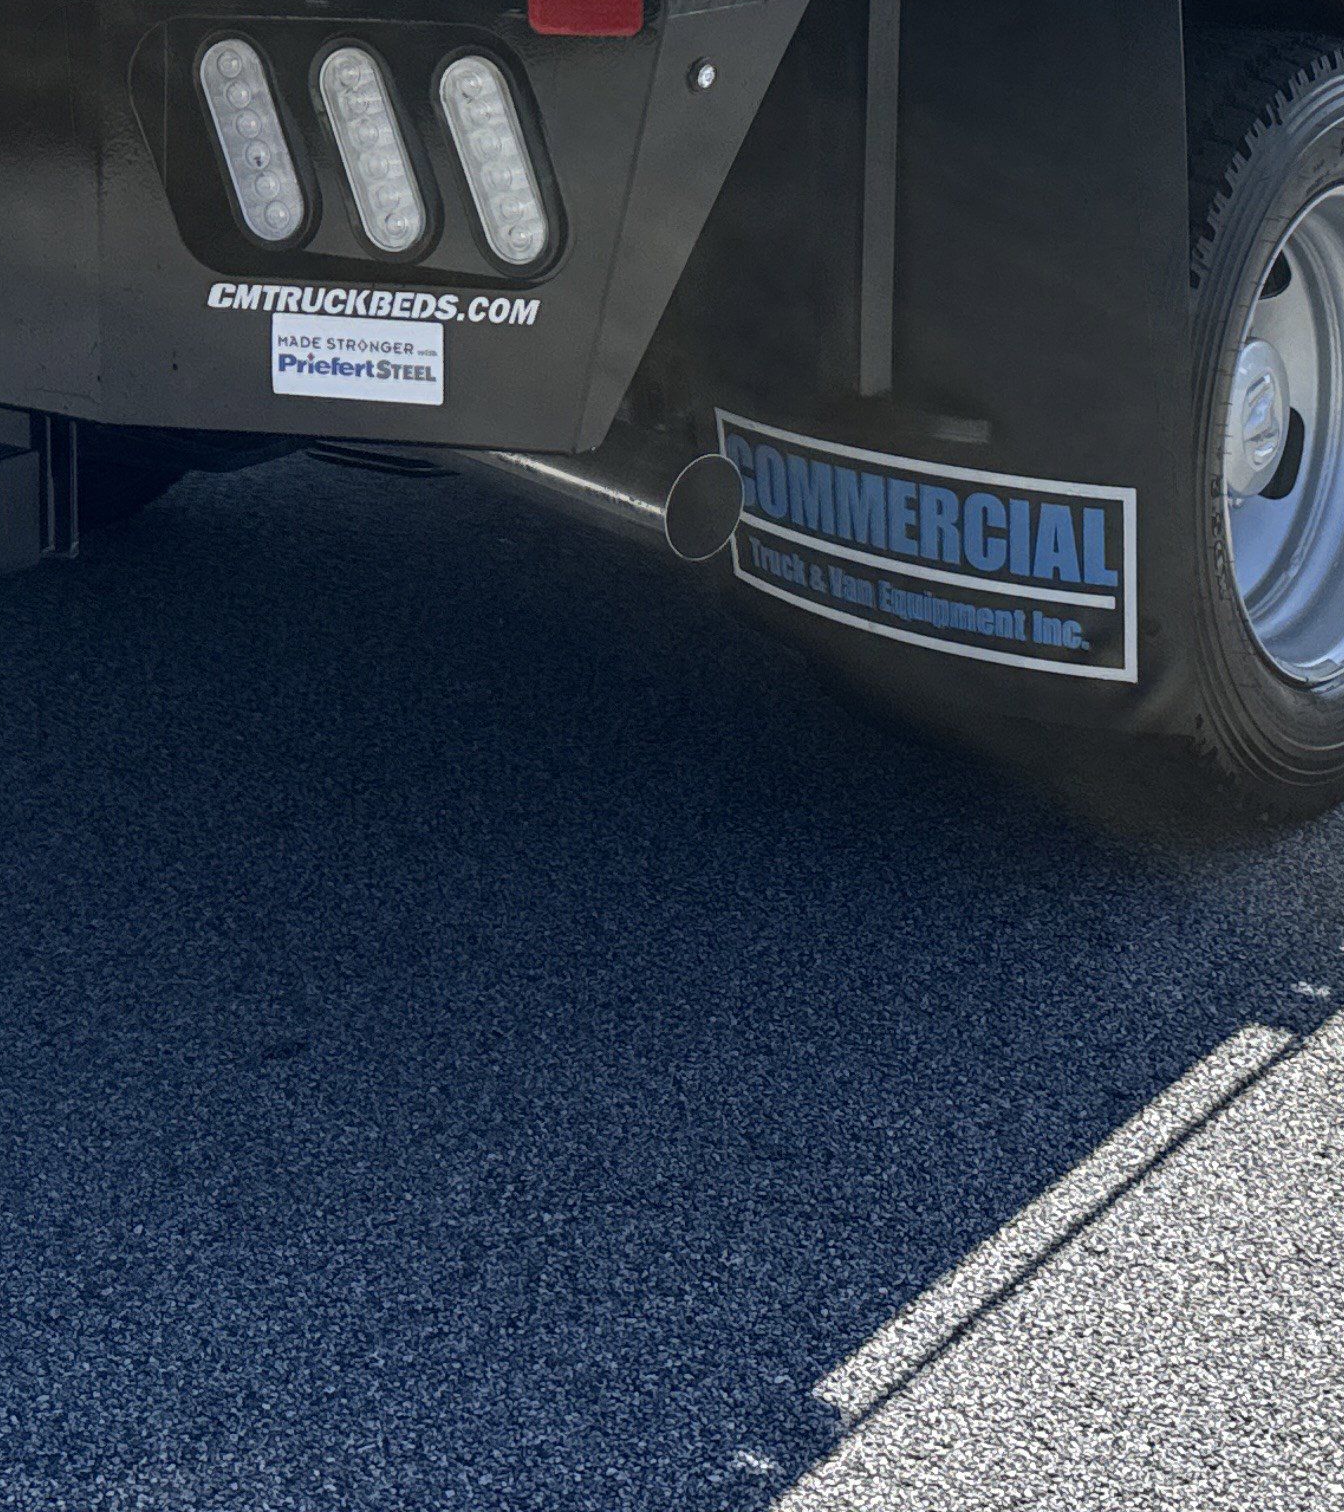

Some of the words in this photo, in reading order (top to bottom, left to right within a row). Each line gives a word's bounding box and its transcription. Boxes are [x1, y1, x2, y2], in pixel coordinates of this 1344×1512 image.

[207, 282, 541, 326] CMTRUCKBEDS.COM
[277, 335, 321, 350] MADE
[326, 337, 414, 356] STRONGER
[726, 432, 1118, 588] COMMERCIAL
[749, 535, 806, 587] Truck
[809, 564, 827, 593] &
[828, 565, 873, 608] Van
[878, 579, 1027, 643] Equipment
[1032, 610, 1090, 651] Inc.
